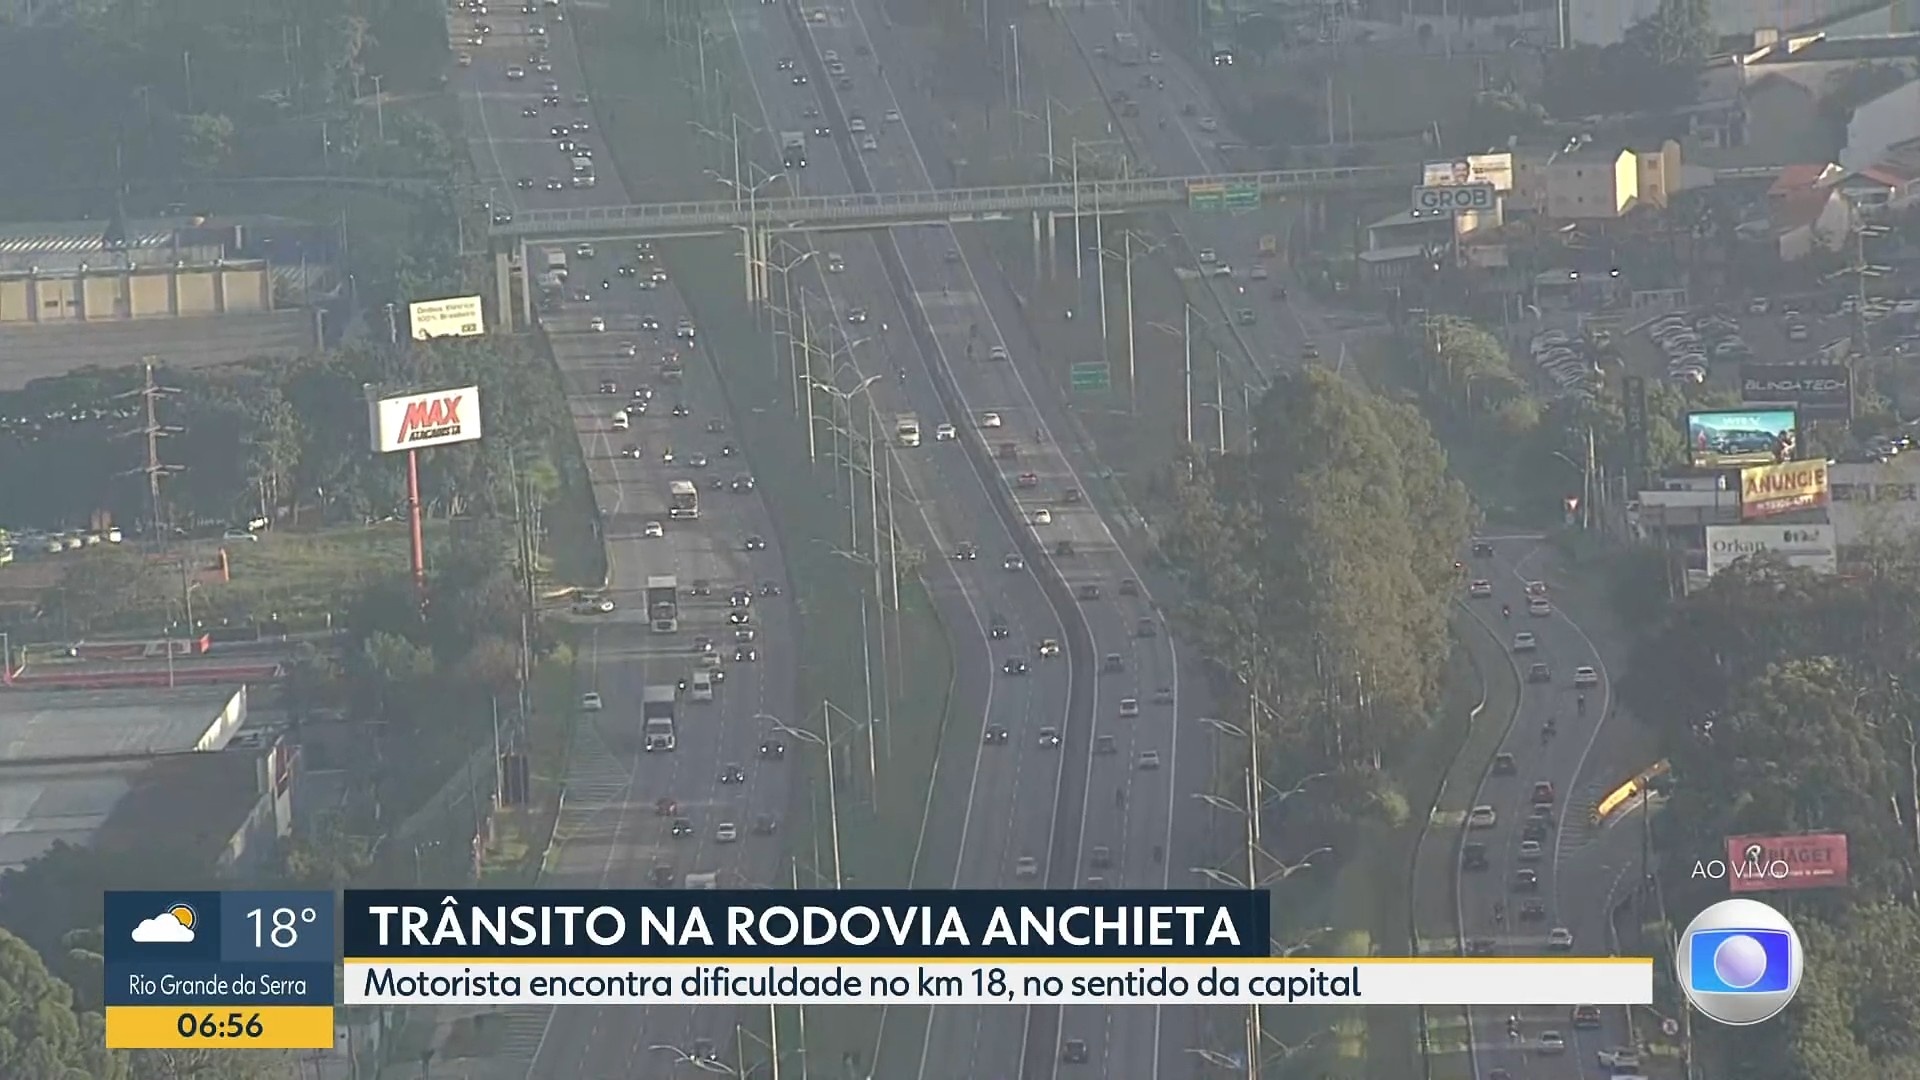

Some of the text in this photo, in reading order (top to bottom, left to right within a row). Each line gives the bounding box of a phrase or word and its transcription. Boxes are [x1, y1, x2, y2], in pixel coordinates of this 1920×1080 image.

[1421, 189, 1487, 207] GROB
[397, 396, 463, 444] MAX
[1745, 468, 1825, 496] ANUNCIE
